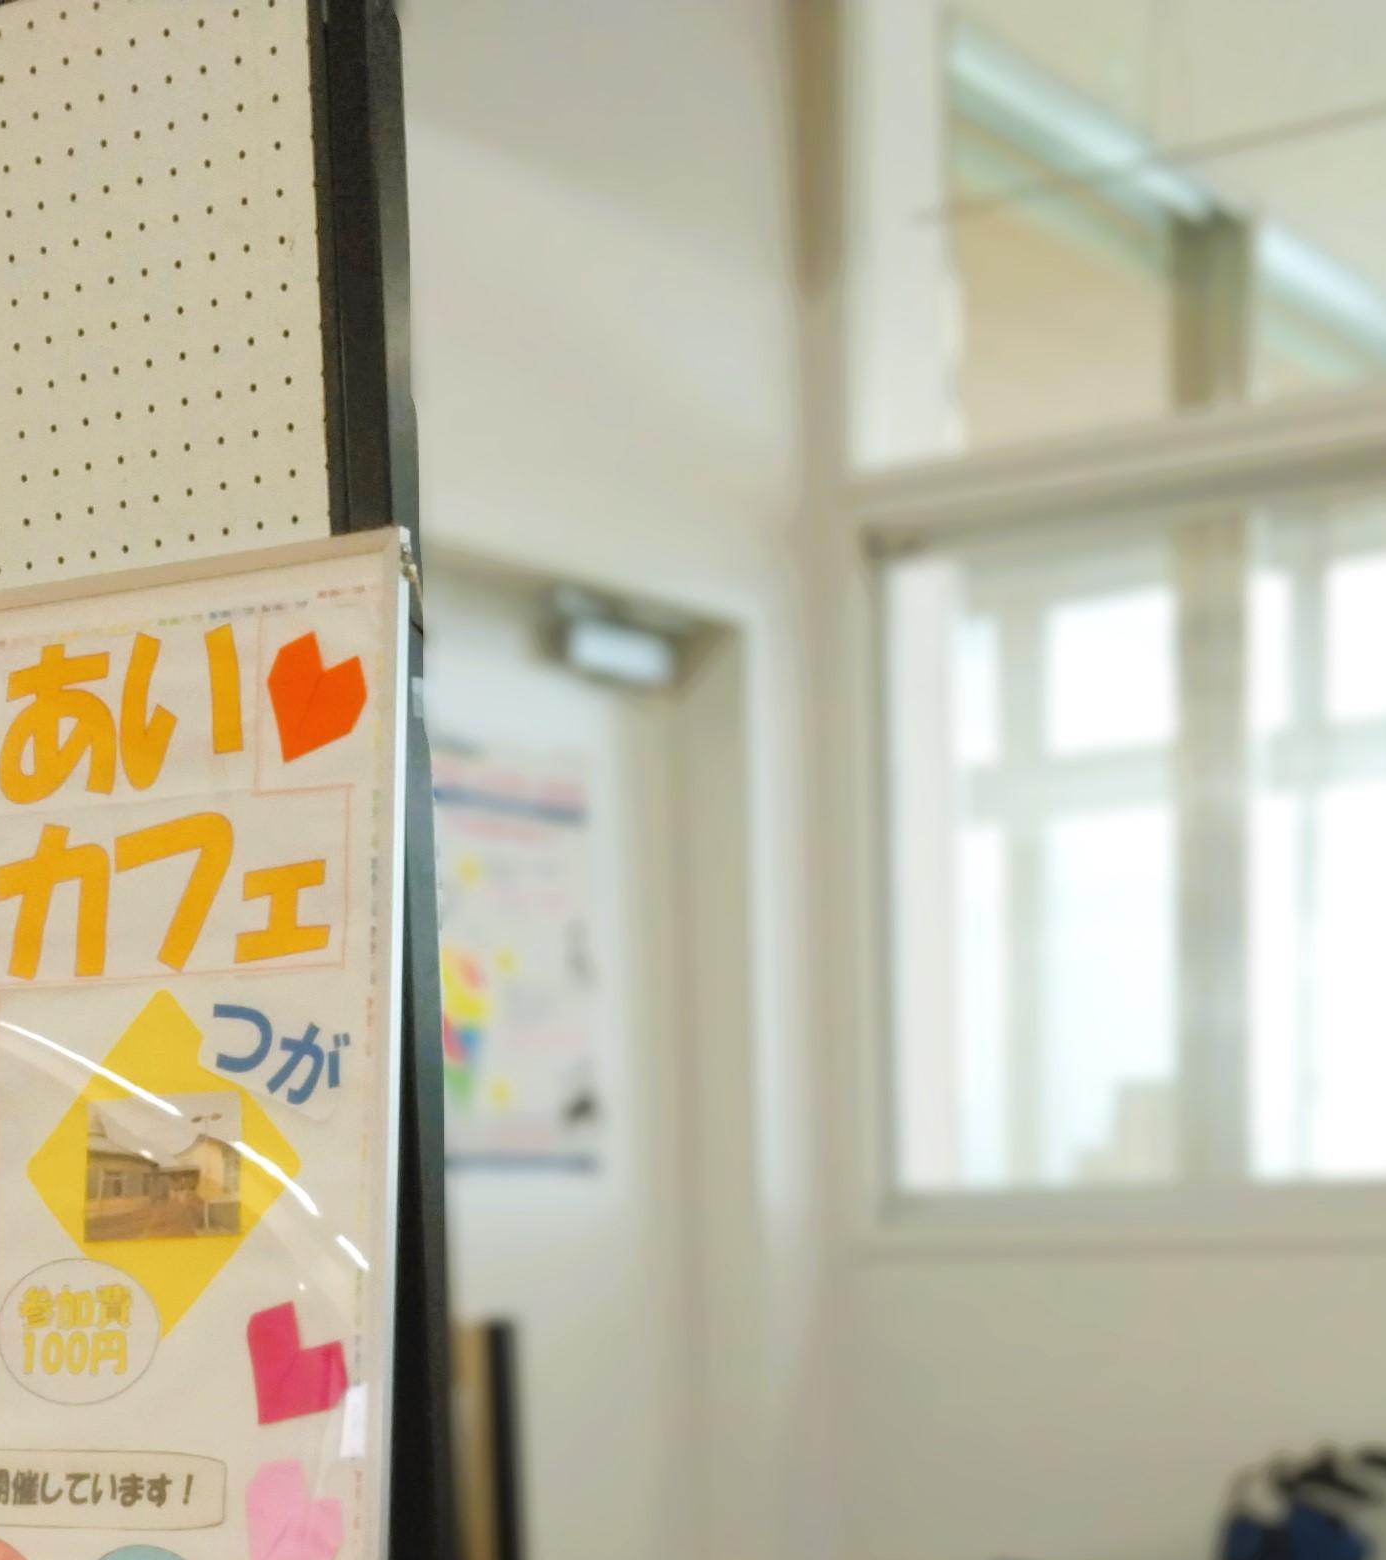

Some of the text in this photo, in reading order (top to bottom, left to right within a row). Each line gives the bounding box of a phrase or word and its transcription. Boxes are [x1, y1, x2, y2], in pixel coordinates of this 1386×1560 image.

[213, 1003, 351, 1106] つが
[19, 1284, 132, 1331] 参加費
[22, 1330, 129, 1377] 100円
